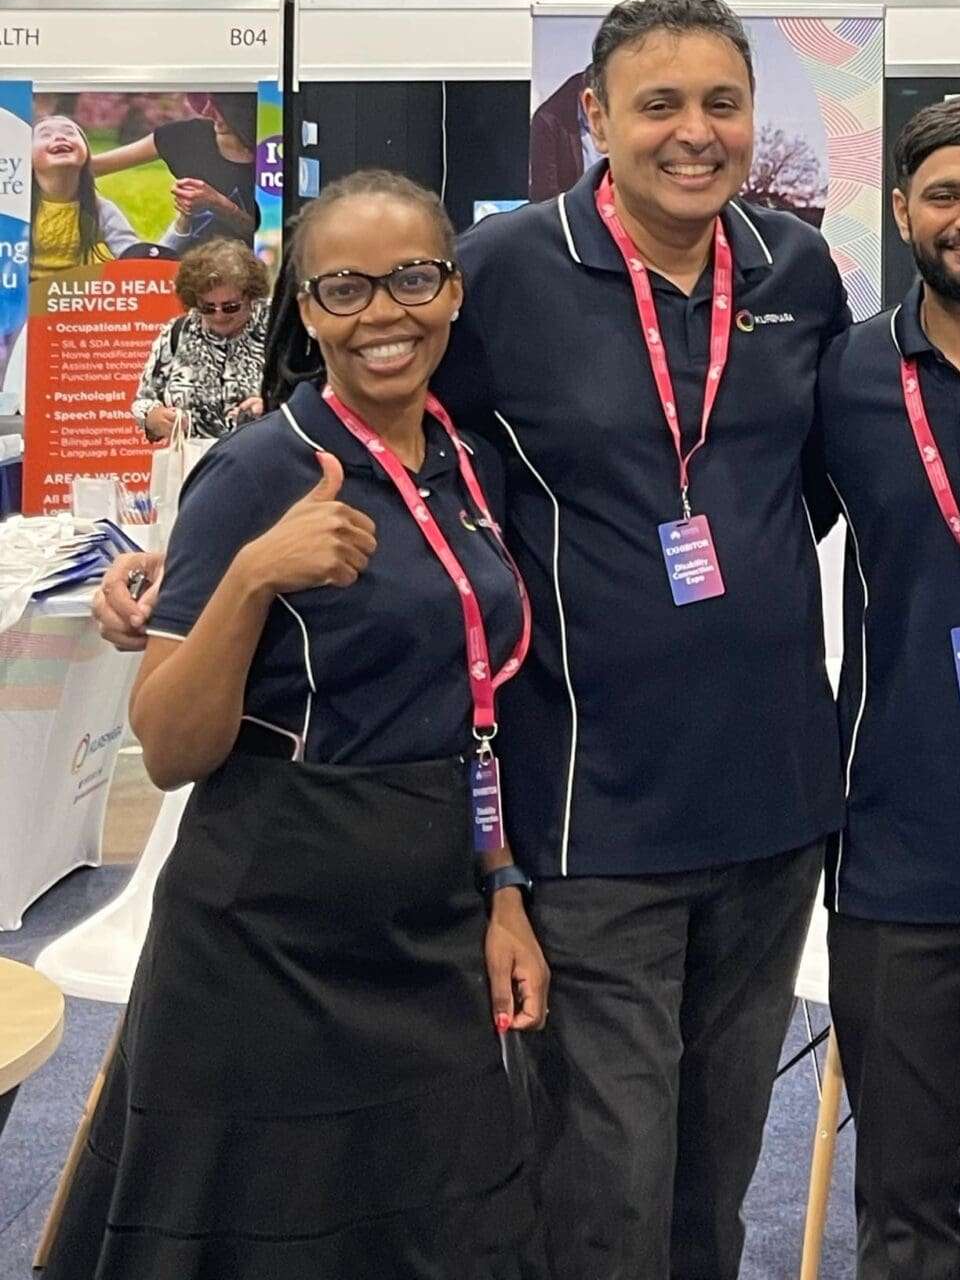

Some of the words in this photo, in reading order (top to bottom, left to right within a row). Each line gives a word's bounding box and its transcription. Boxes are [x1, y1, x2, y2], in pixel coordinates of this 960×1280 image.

[0, 28, 39, 46] LTH
[229, 28, 268, 46] B04
[47, 281, 117, 296] ALLIED
[47, 297, 139, 313] SERVICES
[56, 322, 131, 333] Occupational
[54, 391, 126, 402] Psychologist
[53, 410, 97, 422] Speech
